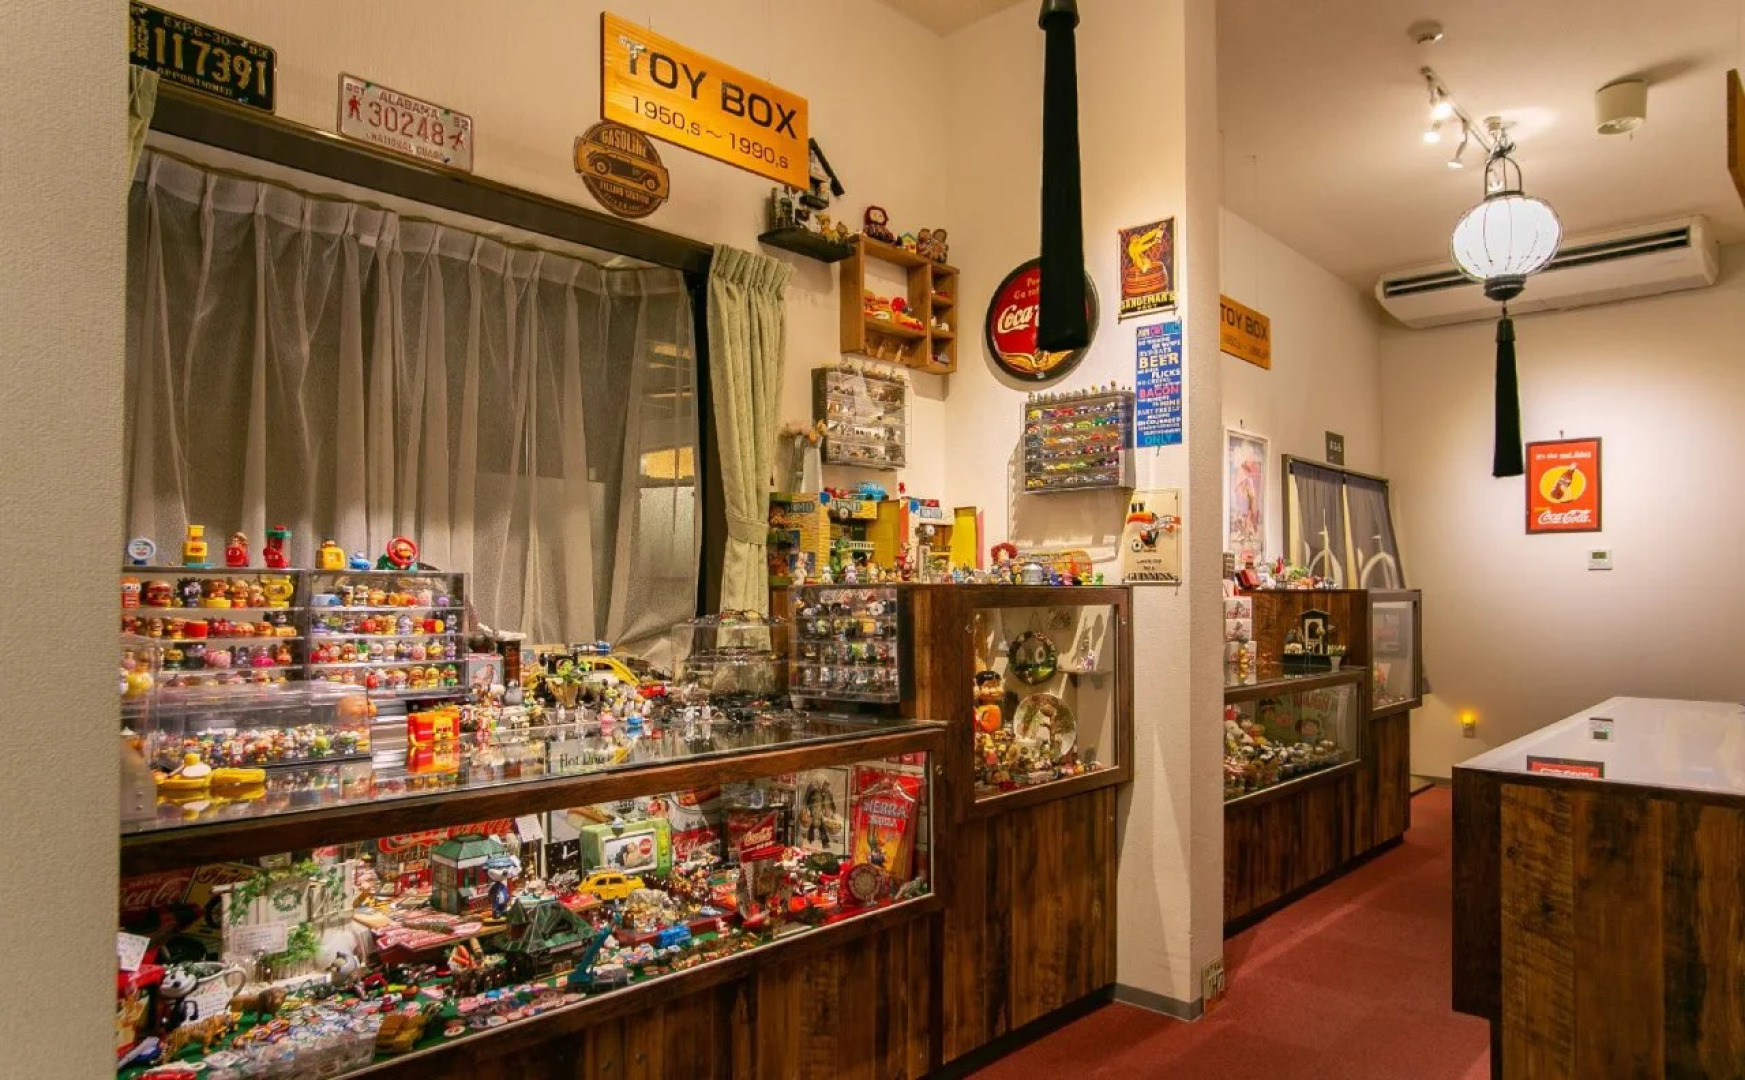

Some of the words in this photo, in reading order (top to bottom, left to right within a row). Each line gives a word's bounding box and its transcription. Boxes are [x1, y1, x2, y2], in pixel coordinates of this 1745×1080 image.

[154, 26, 267, 98] 117391
[618, 33, 706, 100] TOY
[720, 79, 797, 140] BOX
[379, 90, 439, 120] ALABAMA
[368, 100, 444, 147] 30248
[1220, 303, 1243, 330] TOY
[1245, 315, 1268, 342] BOX
[1139, 353, 1178, 368] BEER
[1139, 385, 1178, 398] BACON
[1144, 434, 1172, 445] ONLY
